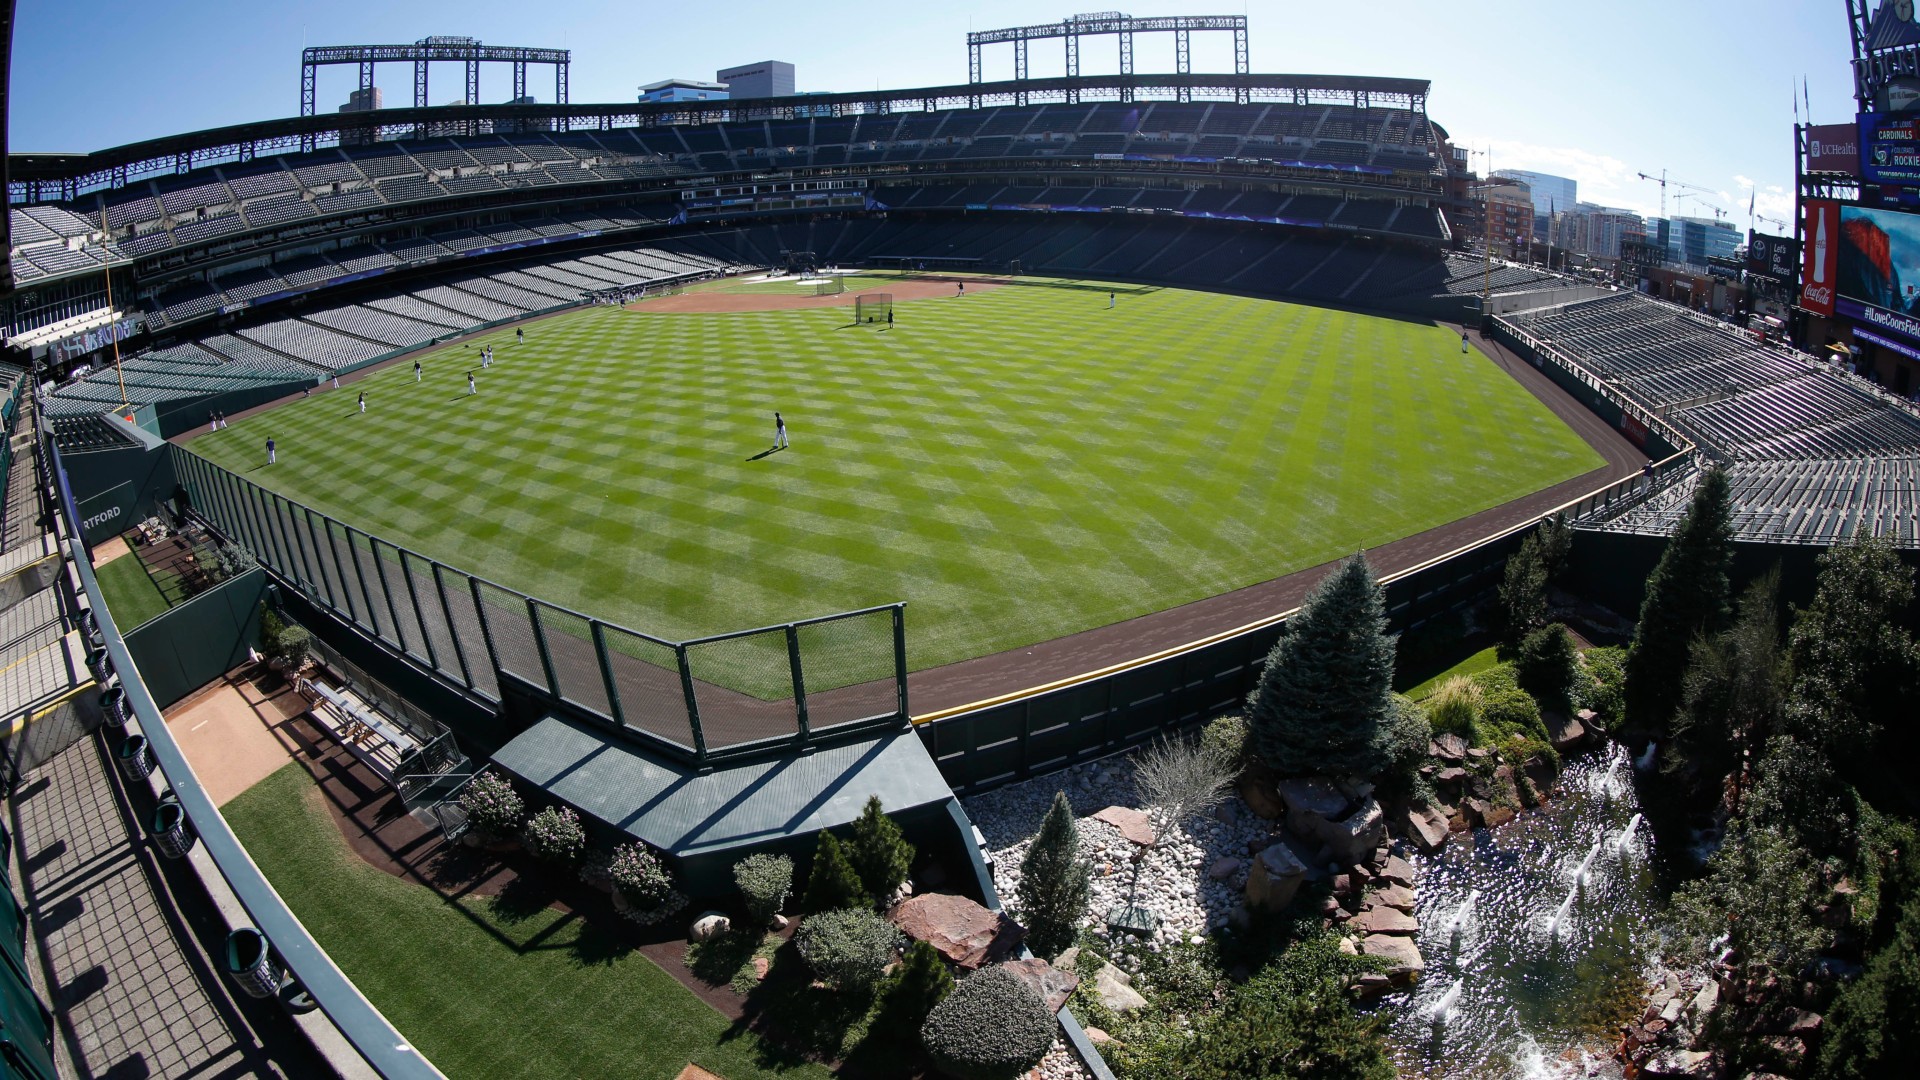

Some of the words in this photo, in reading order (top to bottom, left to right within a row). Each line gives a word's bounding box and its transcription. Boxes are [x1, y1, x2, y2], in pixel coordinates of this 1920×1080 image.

[1878, 130, 1912, 140] CARDINALS
[1822, 142, 1856, 155] UCHealth
[1774, 244, 1786, 254] Let's
[1773, 254, 1781, 263] Go
[1772, 264, 1790, 276] Places
[84, 506, 120, 530] RTFORD
